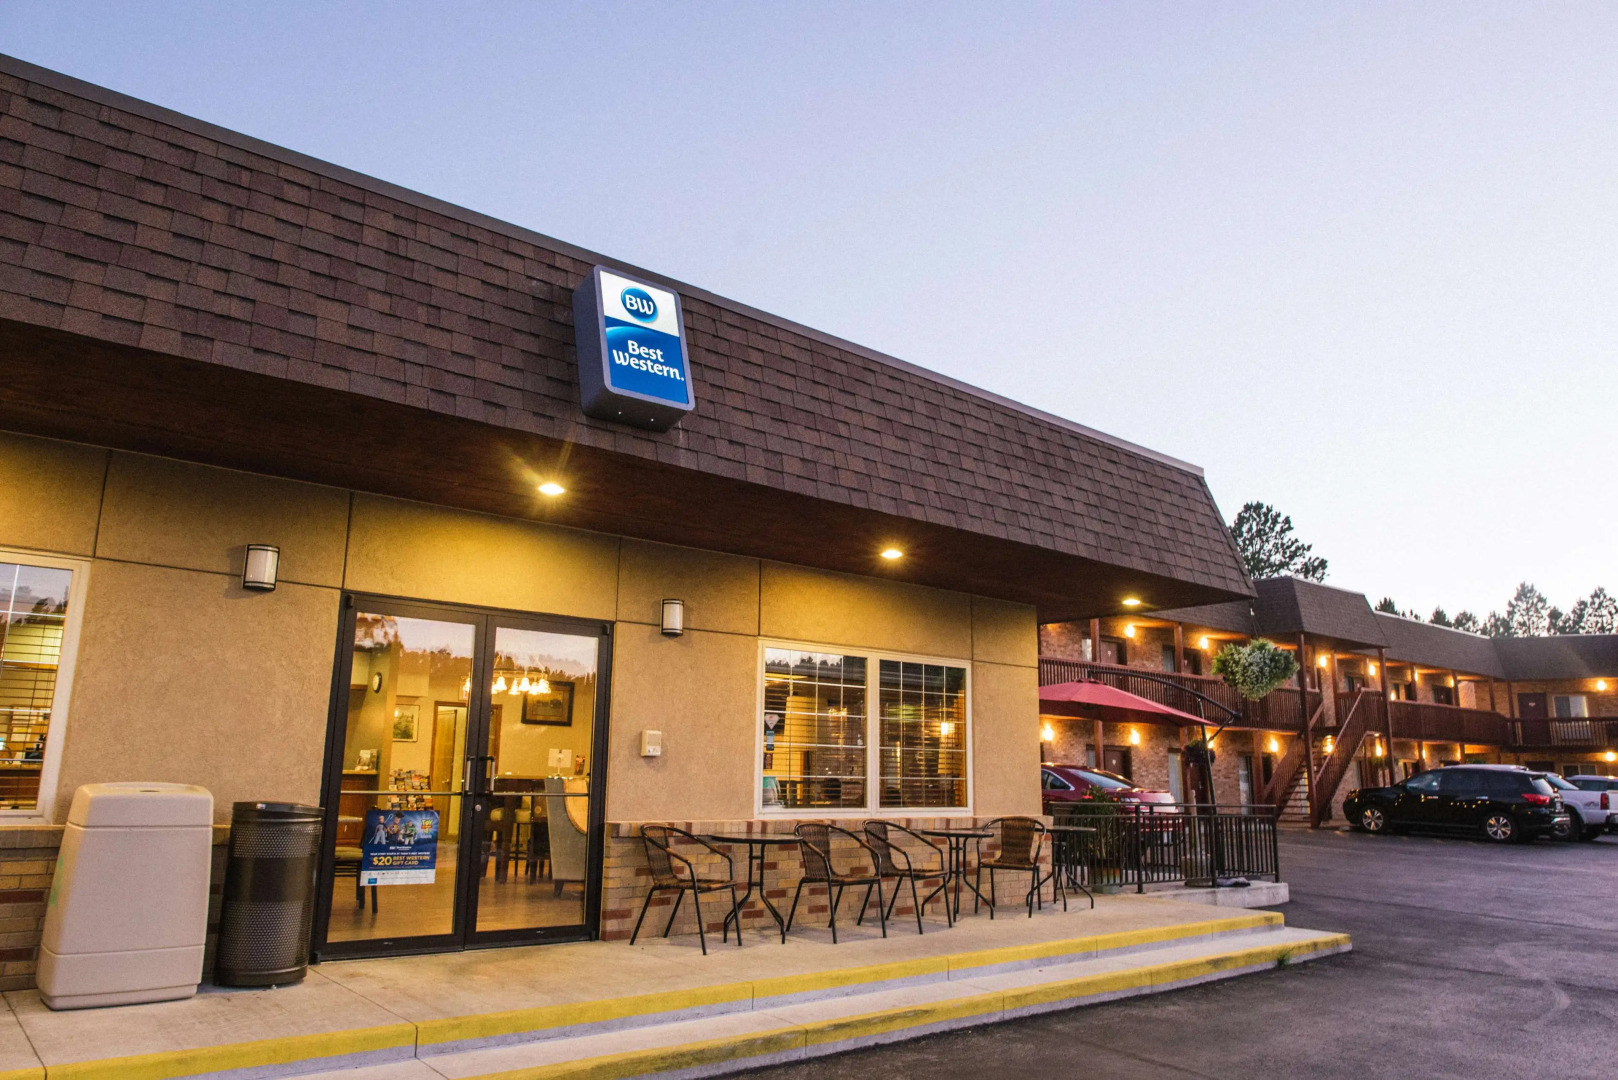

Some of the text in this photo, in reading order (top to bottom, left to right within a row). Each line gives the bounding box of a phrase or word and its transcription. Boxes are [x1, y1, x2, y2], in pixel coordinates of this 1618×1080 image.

[625, 294, 654, 315] BW
[627, 339, 664, 362] Best
[373, 856, 392, 866] $20
